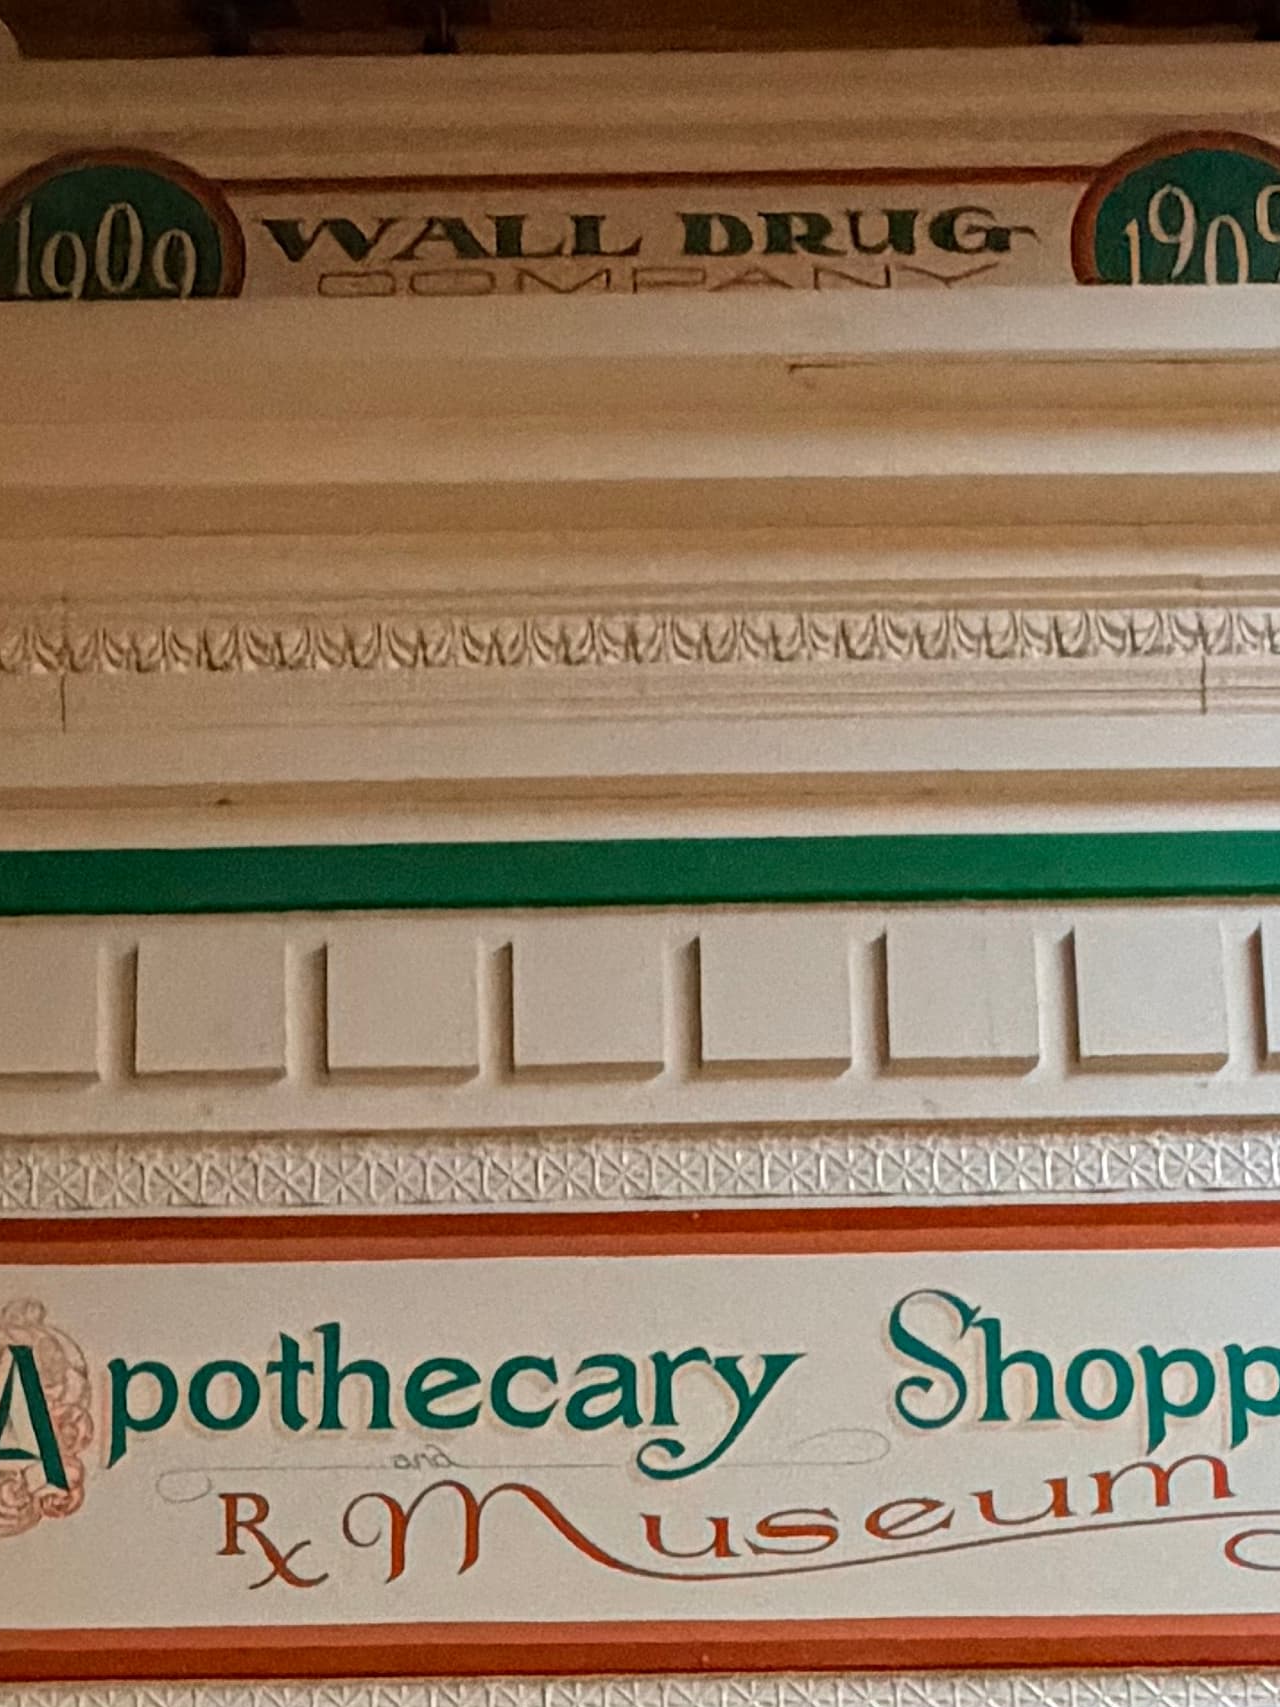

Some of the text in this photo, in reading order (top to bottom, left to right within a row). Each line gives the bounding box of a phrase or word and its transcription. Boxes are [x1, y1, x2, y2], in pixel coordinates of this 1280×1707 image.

[260, 206, 1040, 262] WALL DRUG
[389, 1443, 454, 1470] and
[341, 1454, 1240, 1580] Museum
